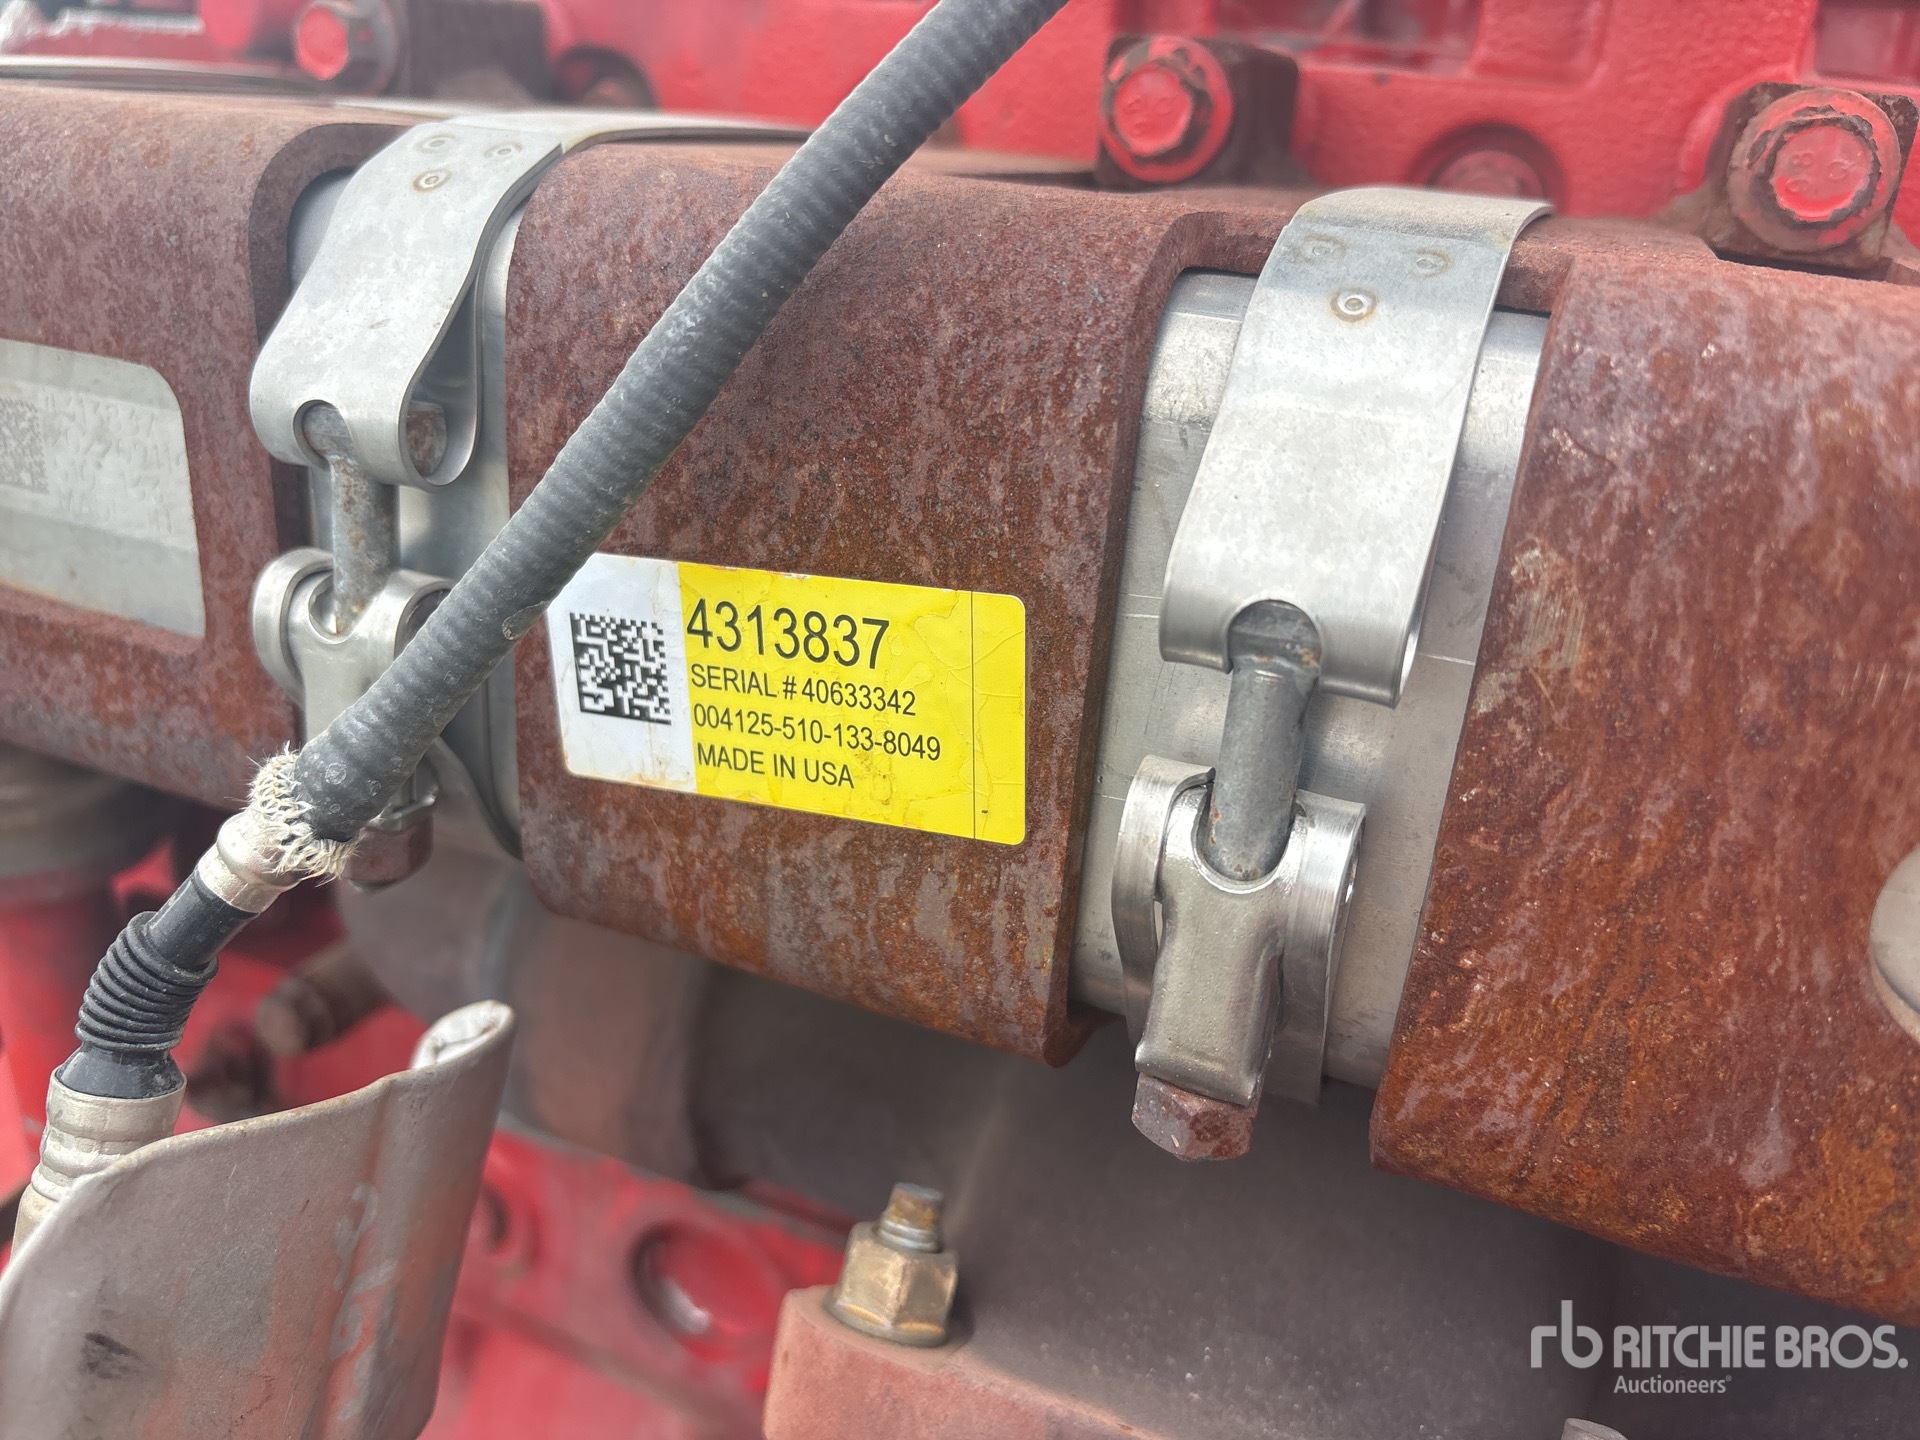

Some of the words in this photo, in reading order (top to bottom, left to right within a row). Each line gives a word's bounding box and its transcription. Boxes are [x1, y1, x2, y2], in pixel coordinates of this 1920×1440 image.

[686, 599, 890, 669] 4313837
[690, 664, 778, 698] SERIAL
[694, 704, 942, 761] 004125-510-133-8049
[697, 743, 765, 776] MADE
[773, 755, 797, 779] IN
[803, 762, 855, 789] USA
